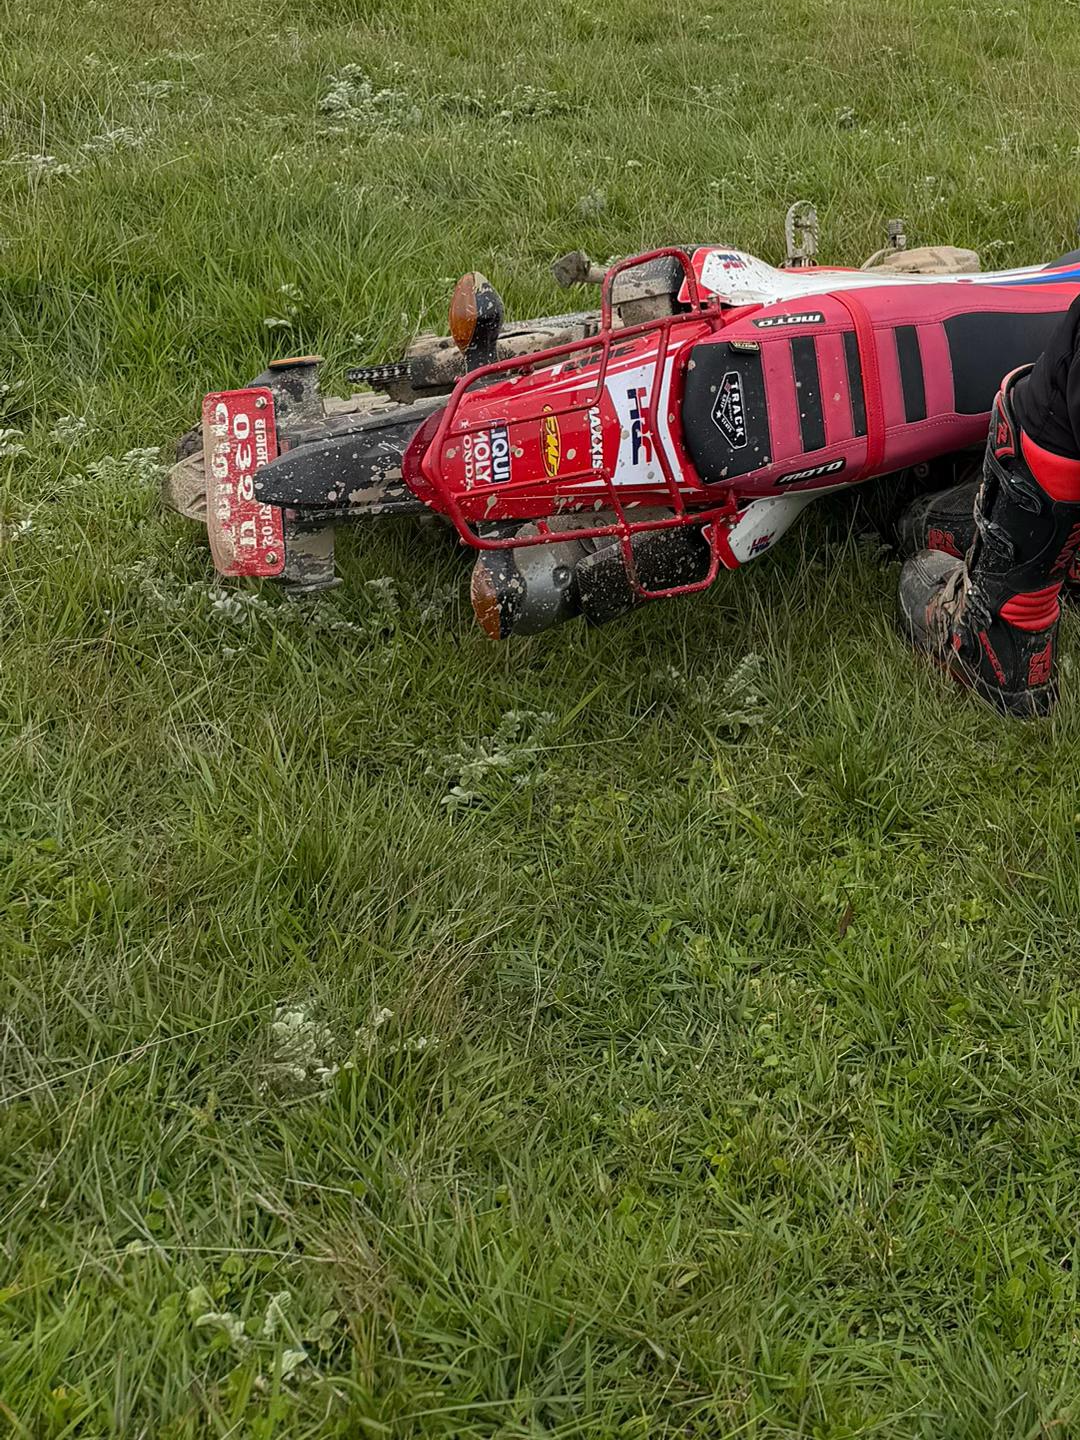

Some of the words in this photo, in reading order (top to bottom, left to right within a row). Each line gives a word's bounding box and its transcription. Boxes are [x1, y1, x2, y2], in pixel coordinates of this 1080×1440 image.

[758, 314, 820, 328] MOTO
[588, 398, 603, 469] MAXXIS
[627, 387, 652, 465] HRC
[731, 381, 744, 437] TRACK
[779, 460, 843, 483] MOTO
